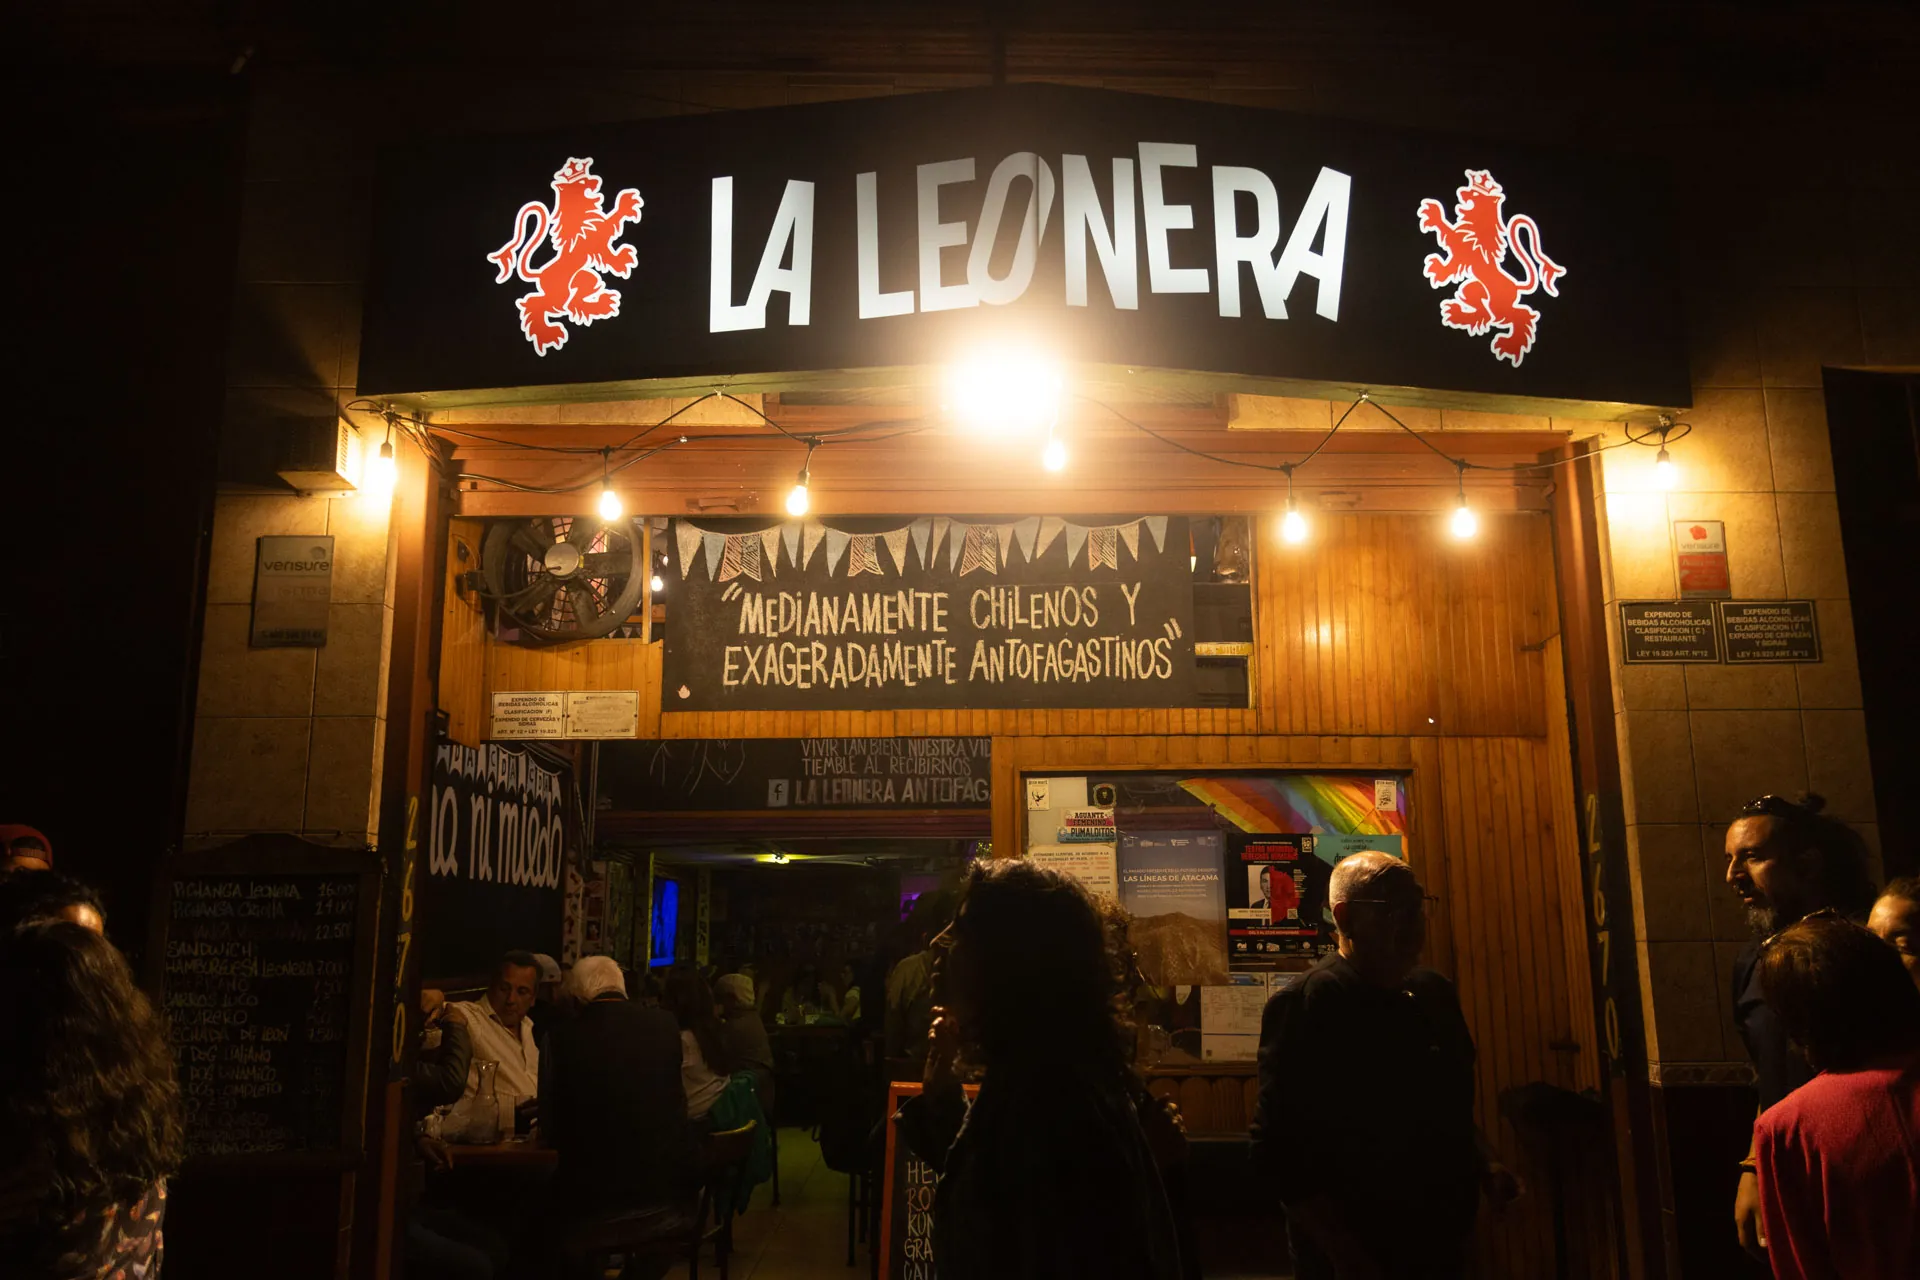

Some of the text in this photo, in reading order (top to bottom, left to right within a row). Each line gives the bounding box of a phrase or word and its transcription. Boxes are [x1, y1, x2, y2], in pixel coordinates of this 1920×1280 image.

[710, 141, 1351, 333] LA LEONERA
[263, 561, 330, 572] verisure
[1120, 582, 1141, 625] Y
[1743, 608, 1779, 616] EXPENDIO
[1726, 616, 1757, 624] BEBIDAS
[1734, 624, 1789, 632] CLASIFICACION
[1728, 632, 1763, 640] EXPENDIO
[722, 639, 957, 689] EXAGERADAMENTE
[801, 738, 840, 757] VIVIR
[908, 737, 967, 757] NUESTRA
[802, 755, 972, 777] TIEMBLE AL RECIBIRNOS
[795, 778, 820, 804] LA
[1070, 827, 1115, 838] PUMALDITOS
[393, 796, 418, 1064] 2670
